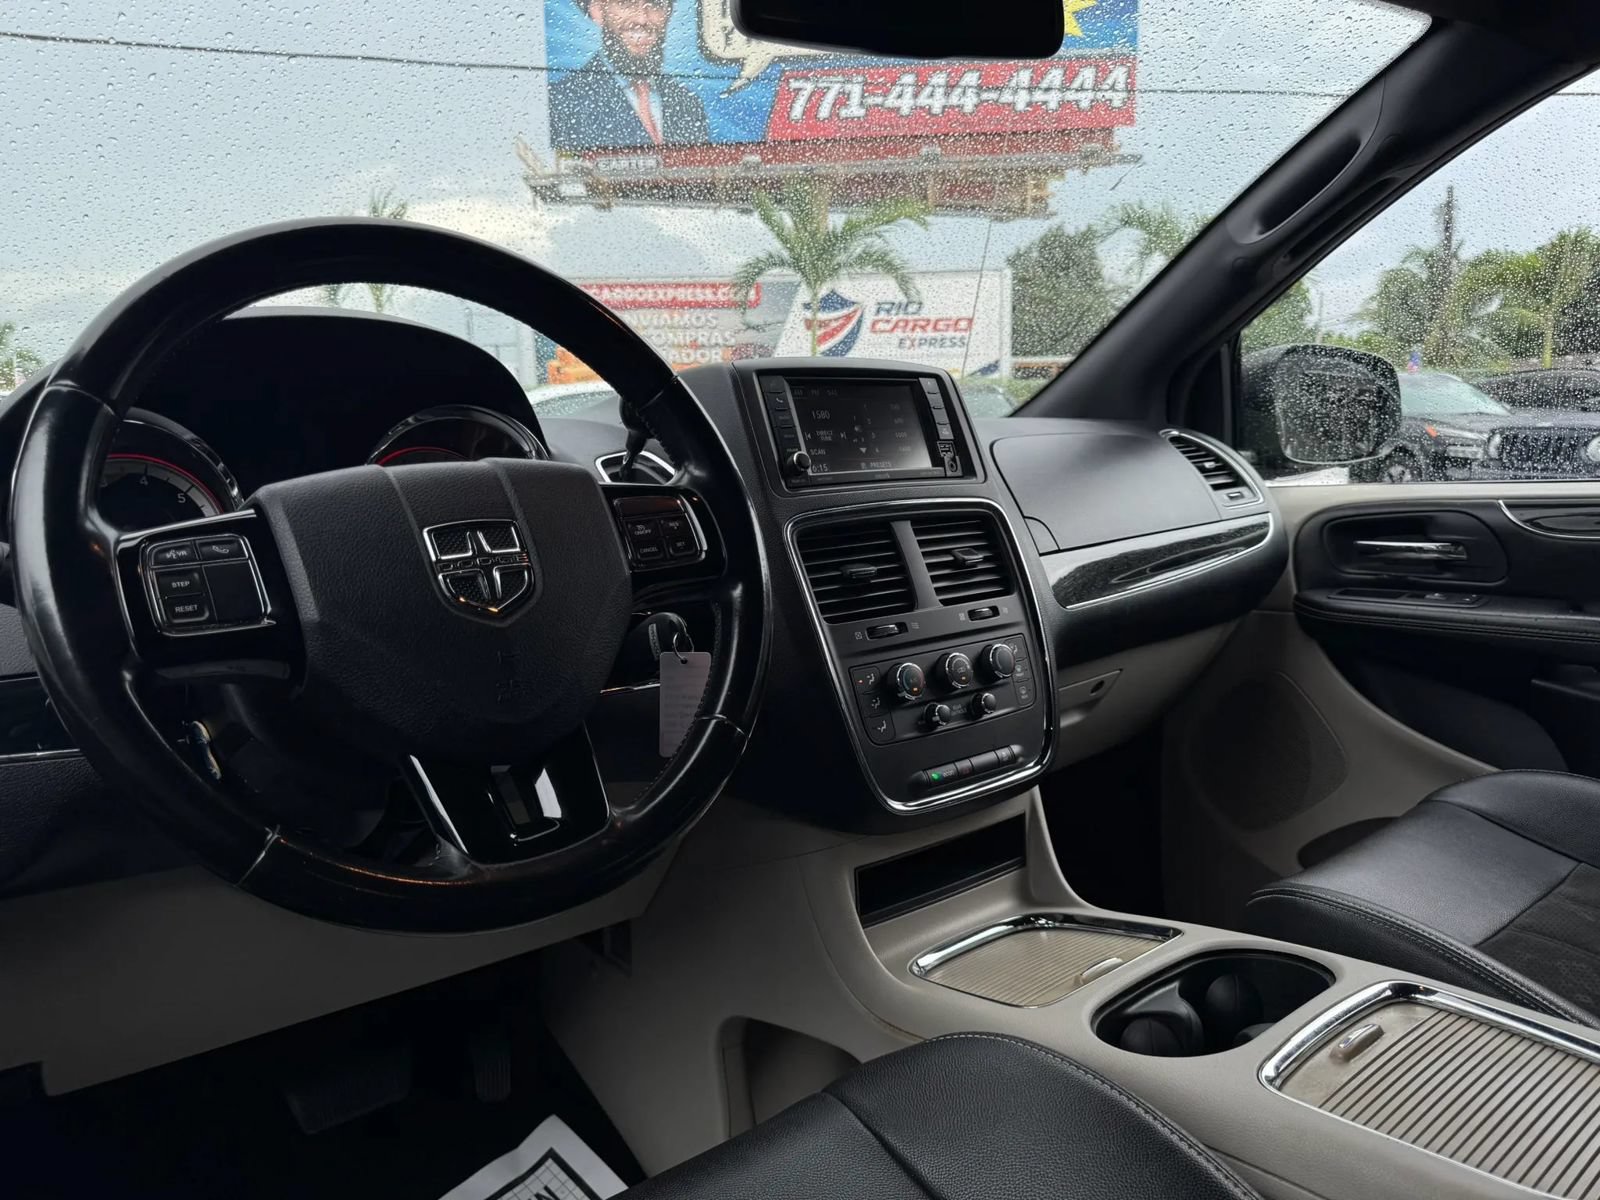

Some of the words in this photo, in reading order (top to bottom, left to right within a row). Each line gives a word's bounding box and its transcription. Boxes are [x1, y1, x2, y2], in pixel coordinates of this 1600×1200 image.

[788, 65, 1129, 121] 771-444-4444
[875, 301, 922, 316] RIO
[620, 312, 717, 329] NVIAMOS
[870, 316, 973, 334] CARGO
[899, 335, 967, 349] EXPRESS
[811, 409, 831, 420] 1580
[177, 493, 186, 503] 5
[437, 553, 528, 572] DODGE
[175, 604, 198, 613] RESET
